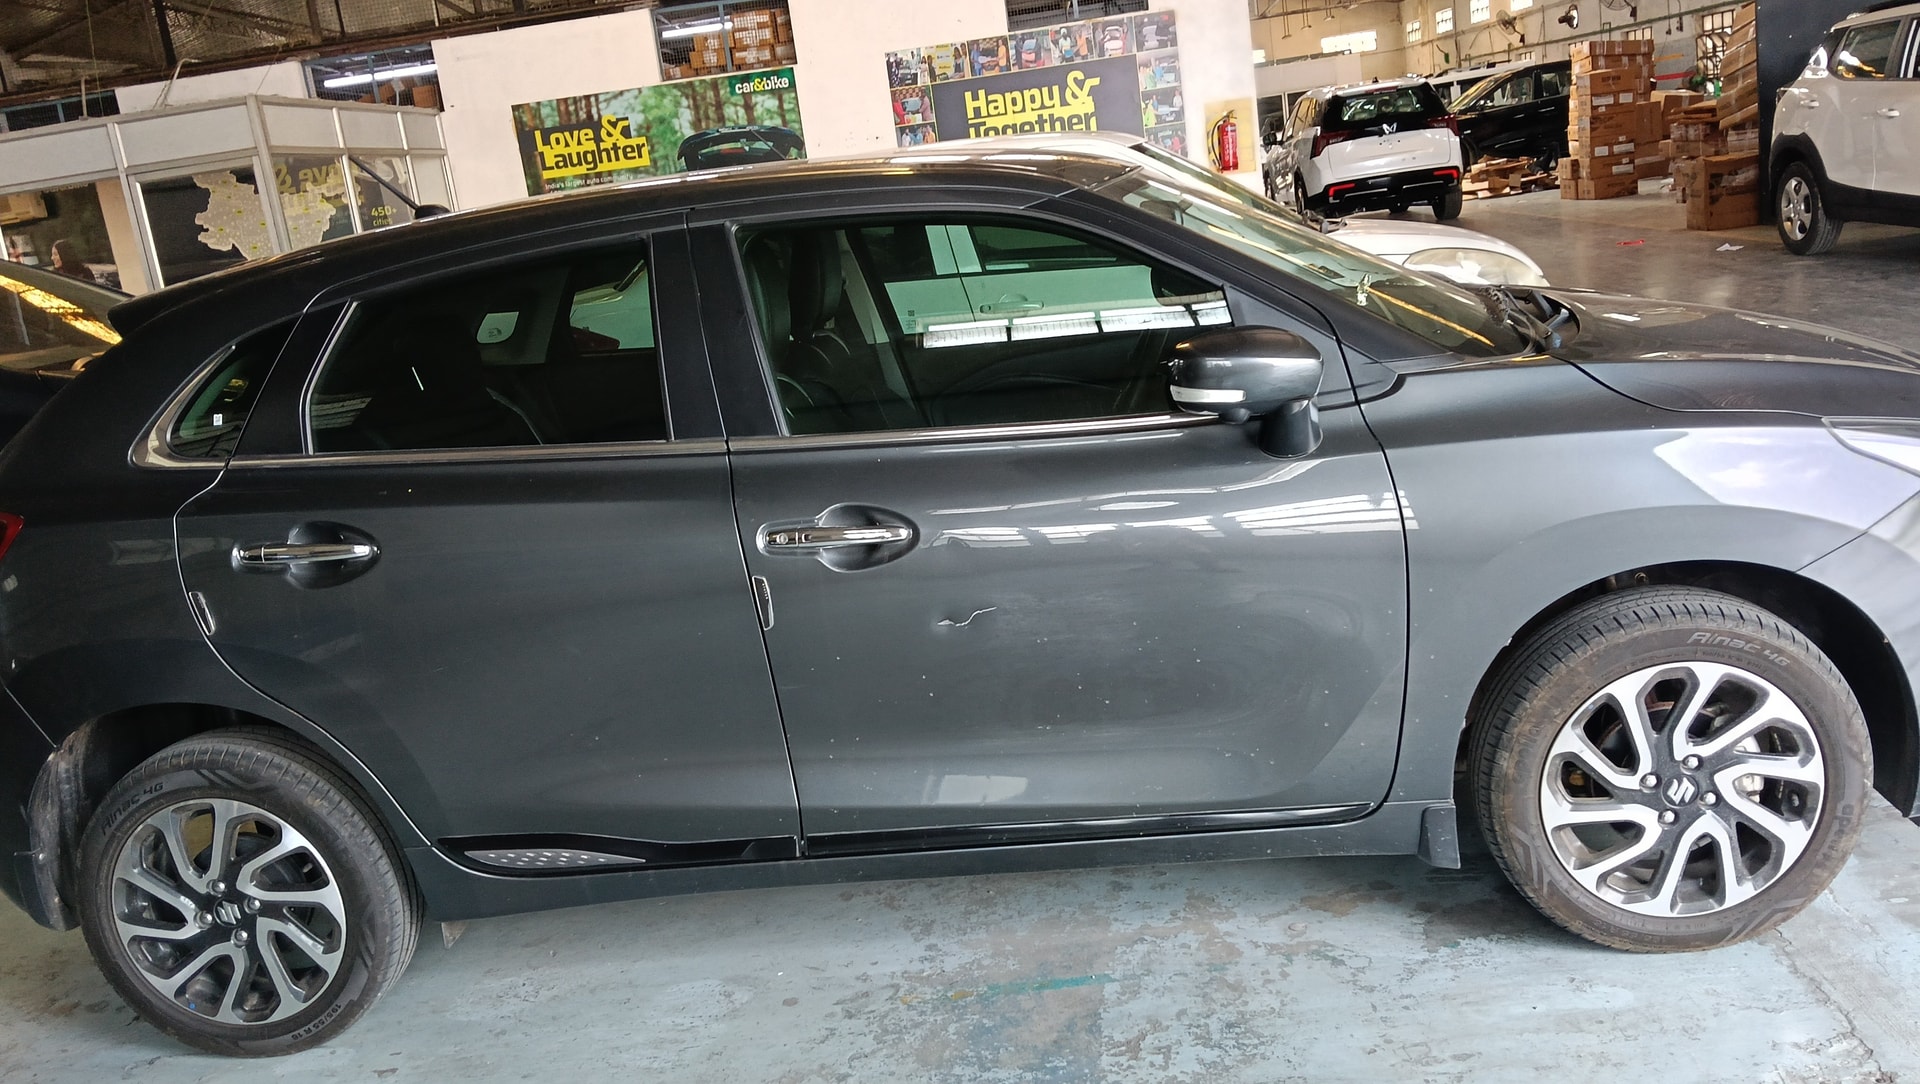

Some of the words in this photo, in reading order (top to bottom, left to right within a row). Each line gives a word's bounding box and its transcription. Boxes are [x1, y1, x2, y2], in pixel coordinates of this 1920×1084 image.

[735, 75, 789, 94] car&bike
[964, 85, 1061, 118] Happy
[1065, 70, 1101, 106] &
[534, 128, 595, 151] Love
[600, 114, 630, 142] &
[538, 142, 646, 171] Laughter
[371, 205, 397, 216] 450+
[1763, 649, 1790, 666] 4G
[143, 782, 164, 794] 4G
